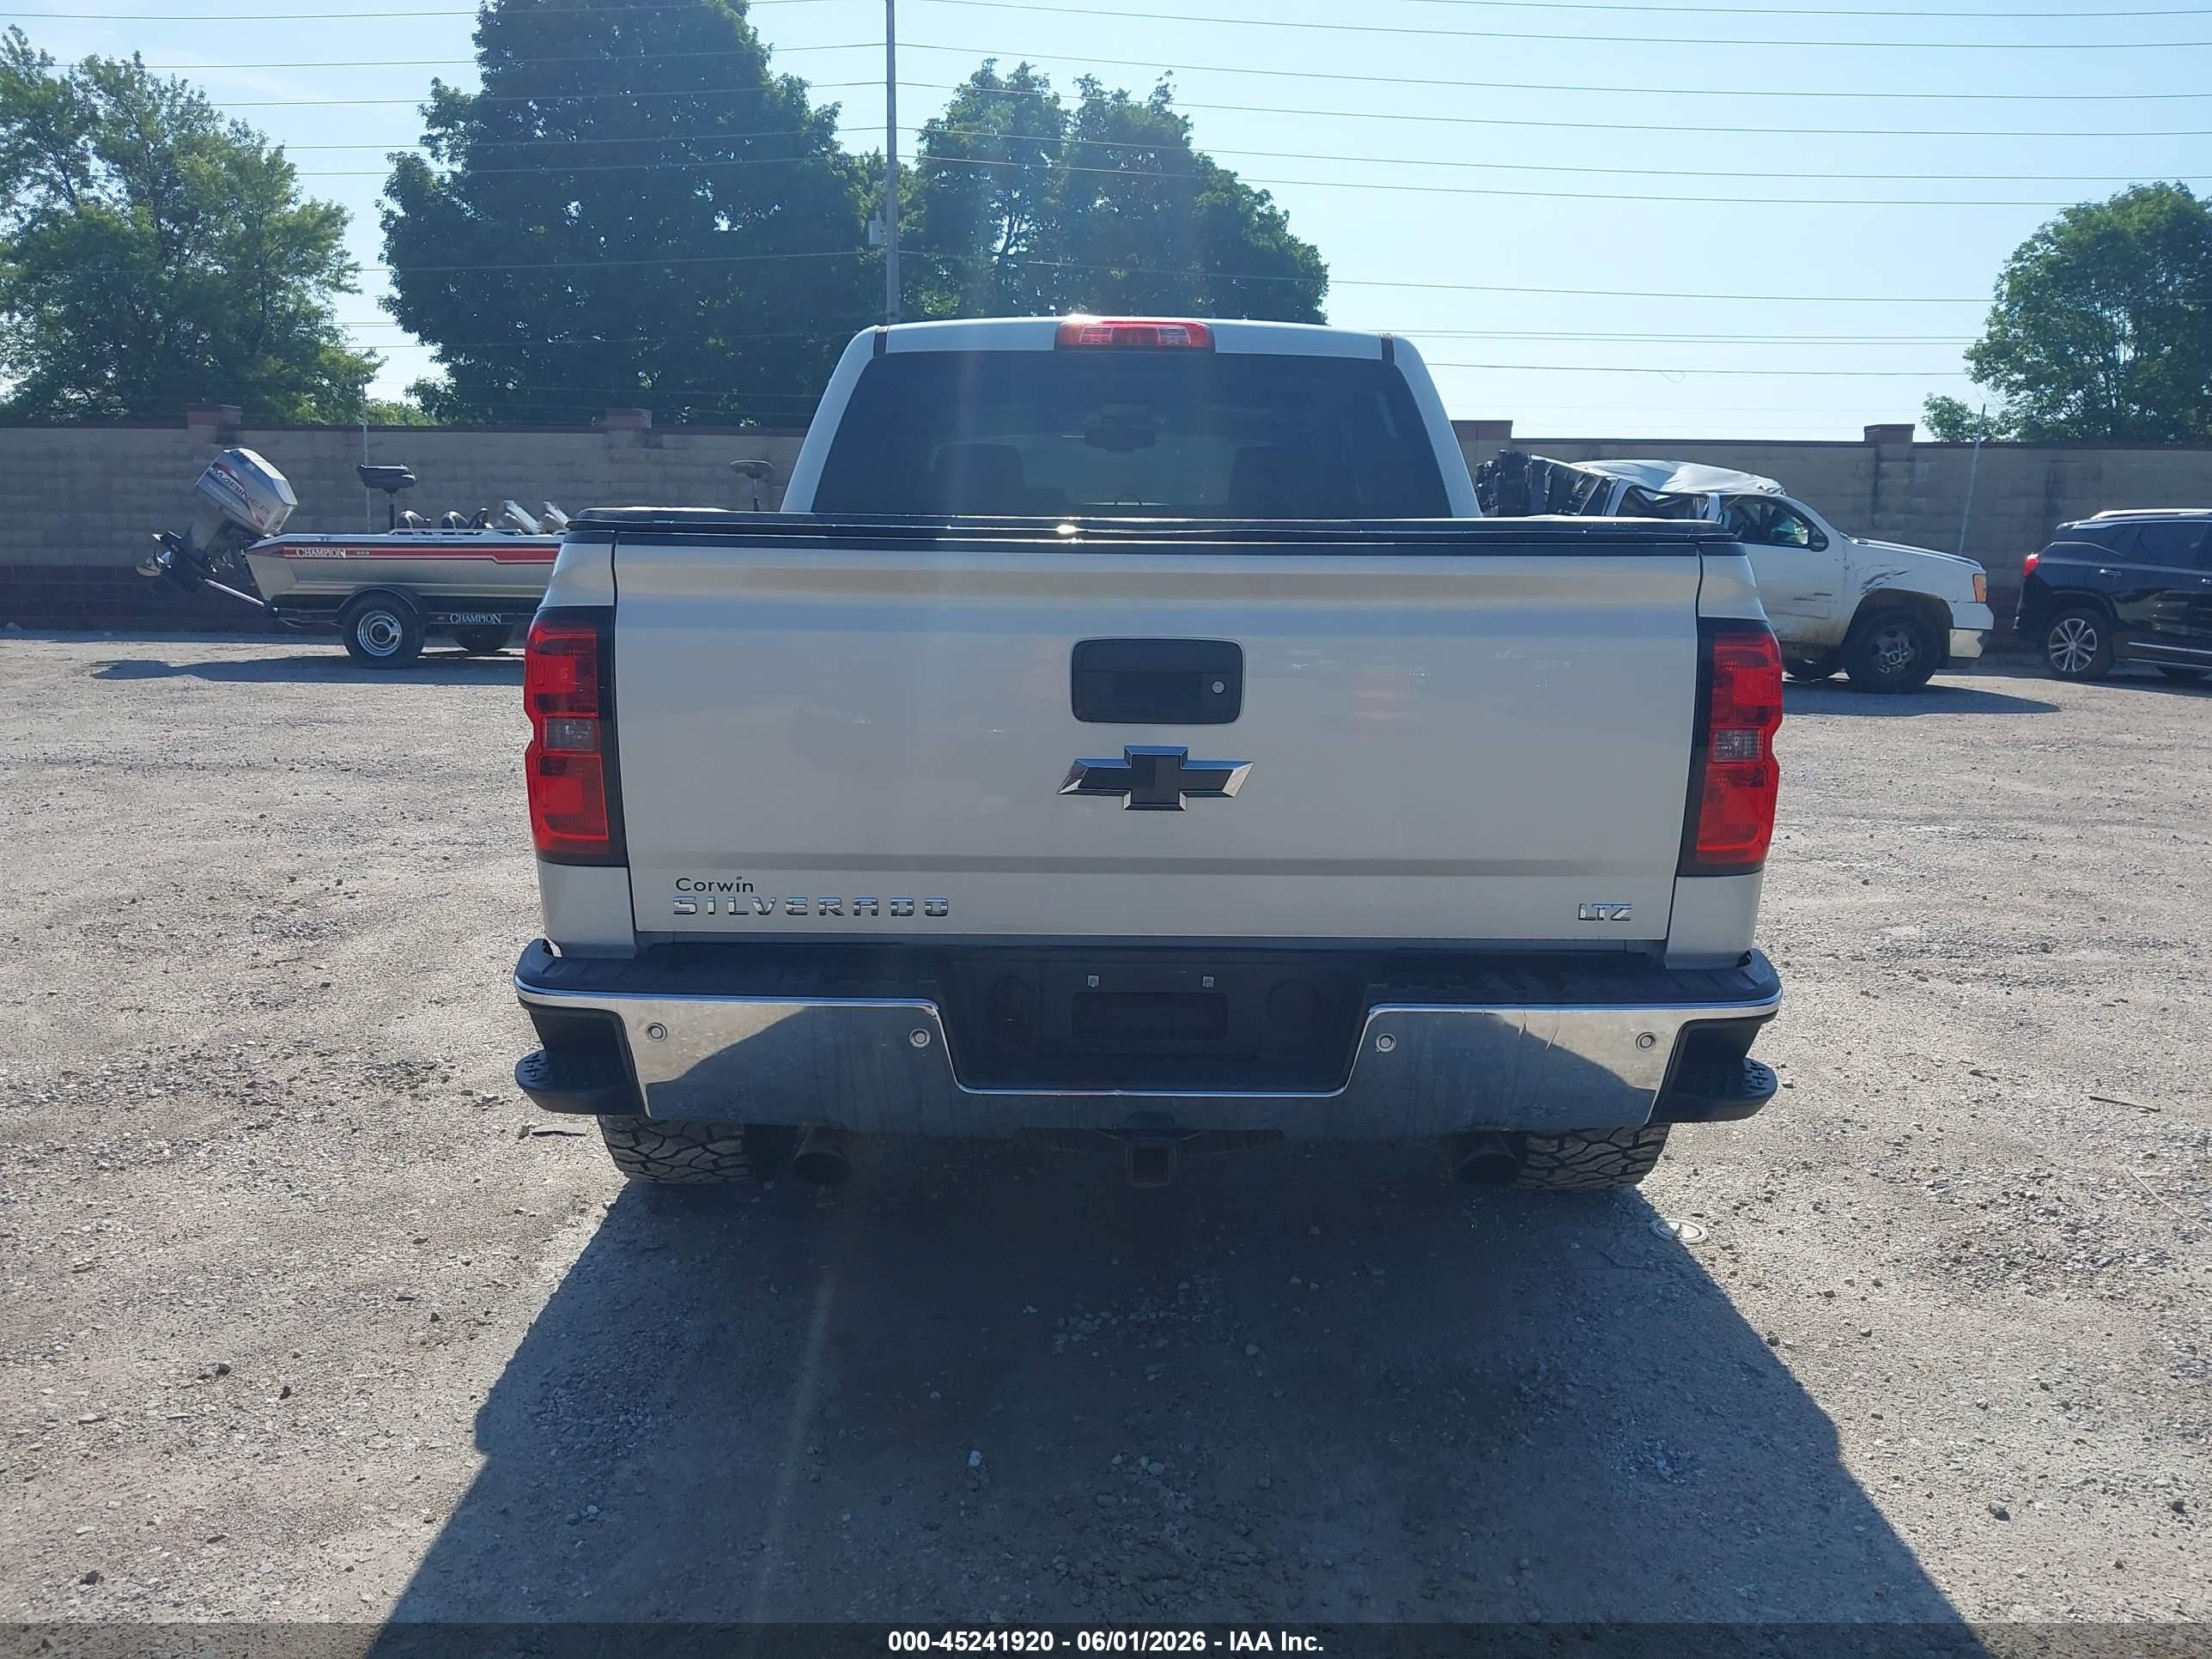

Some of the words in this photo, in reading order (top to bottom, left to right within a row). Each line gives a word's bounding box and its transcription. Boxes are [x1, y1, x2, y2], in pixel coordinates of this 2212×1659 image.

[295, 548, 347, 558] CHAMPION
[449, 613, 501, 624] CHAMPION
[675, 876, 755, 894] Corwin
[672, 896, 949, 917] SILVERADO
[1577, 902, 1633, 921] LTZ
